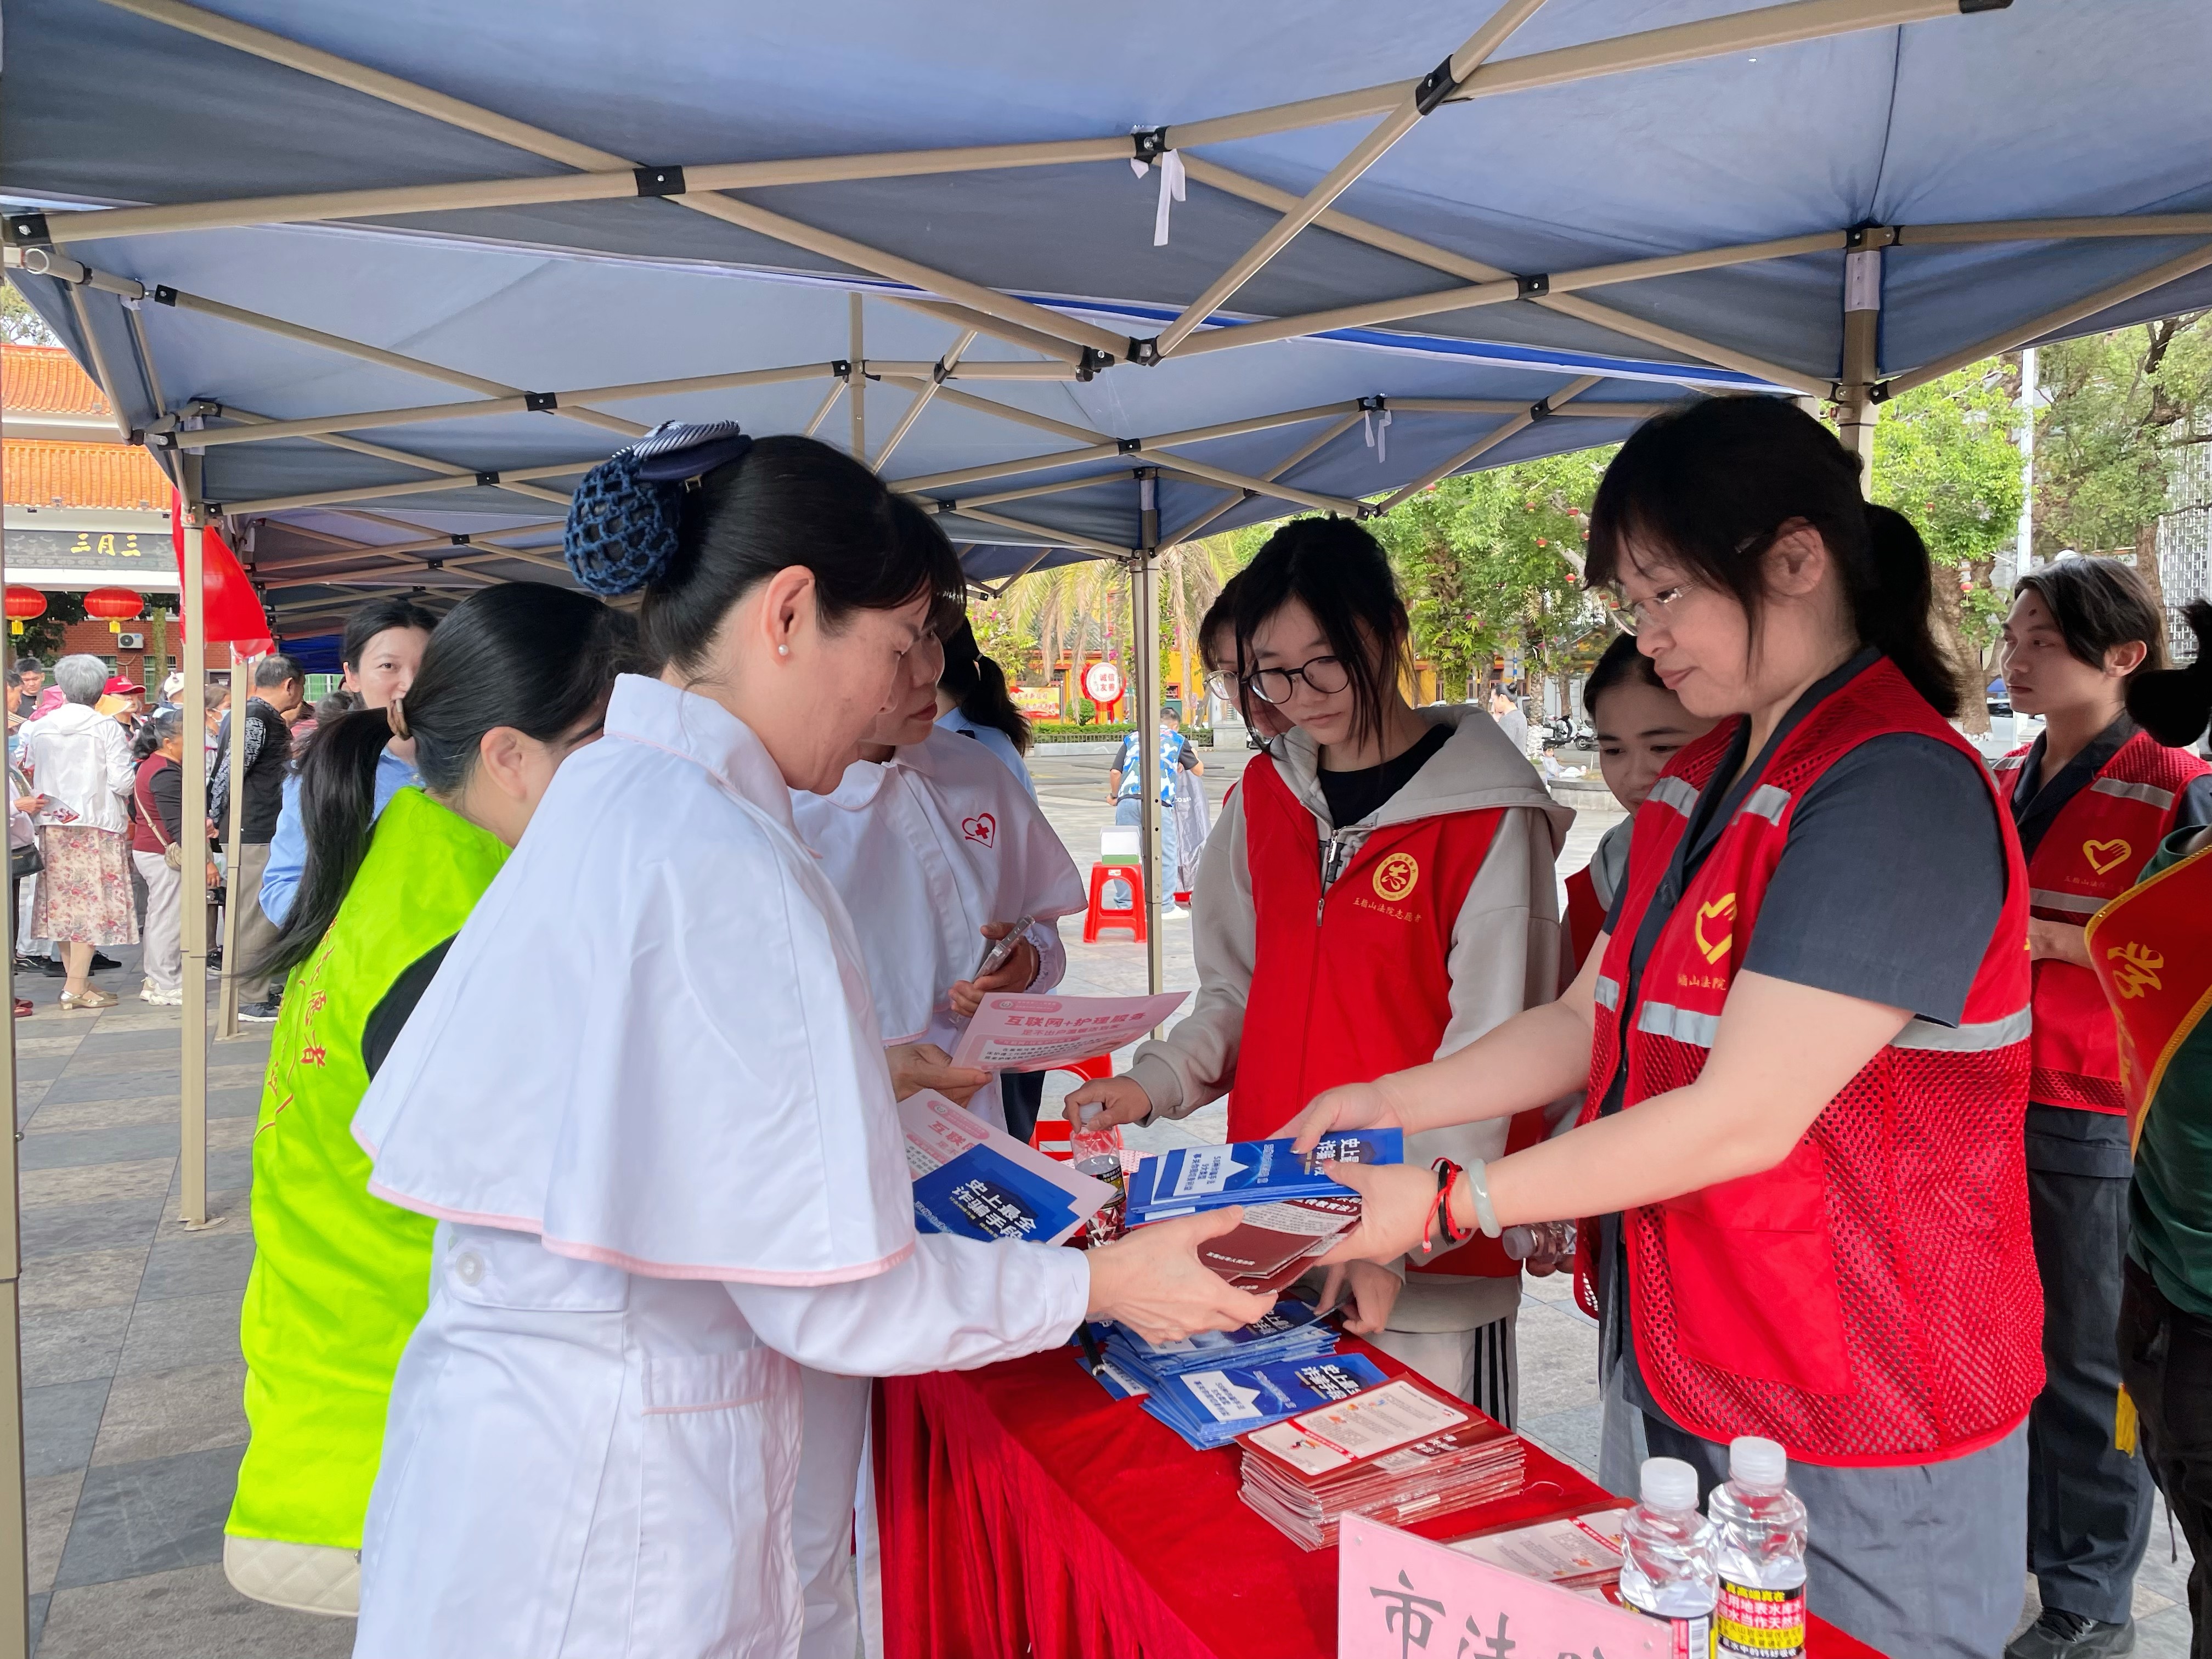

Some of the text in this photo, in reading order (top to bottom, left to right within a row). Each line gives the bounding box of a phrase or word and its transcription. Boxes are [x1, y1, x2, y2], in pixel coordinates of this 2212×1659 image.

[70, 533, 141, 557] 三月三
[1099, 673, 1115, 682] 诚信
[1100, 684, 1115, 692] 友善
[1353, 898, 1422, 923] 五指山法院志愿者
[1004, 1012, 1146, 1028] 互联网+护理服务
[951, 1186, 1024, 1240] 诈骗手段
[965, 1179, 1037, 1234] 史上最全
